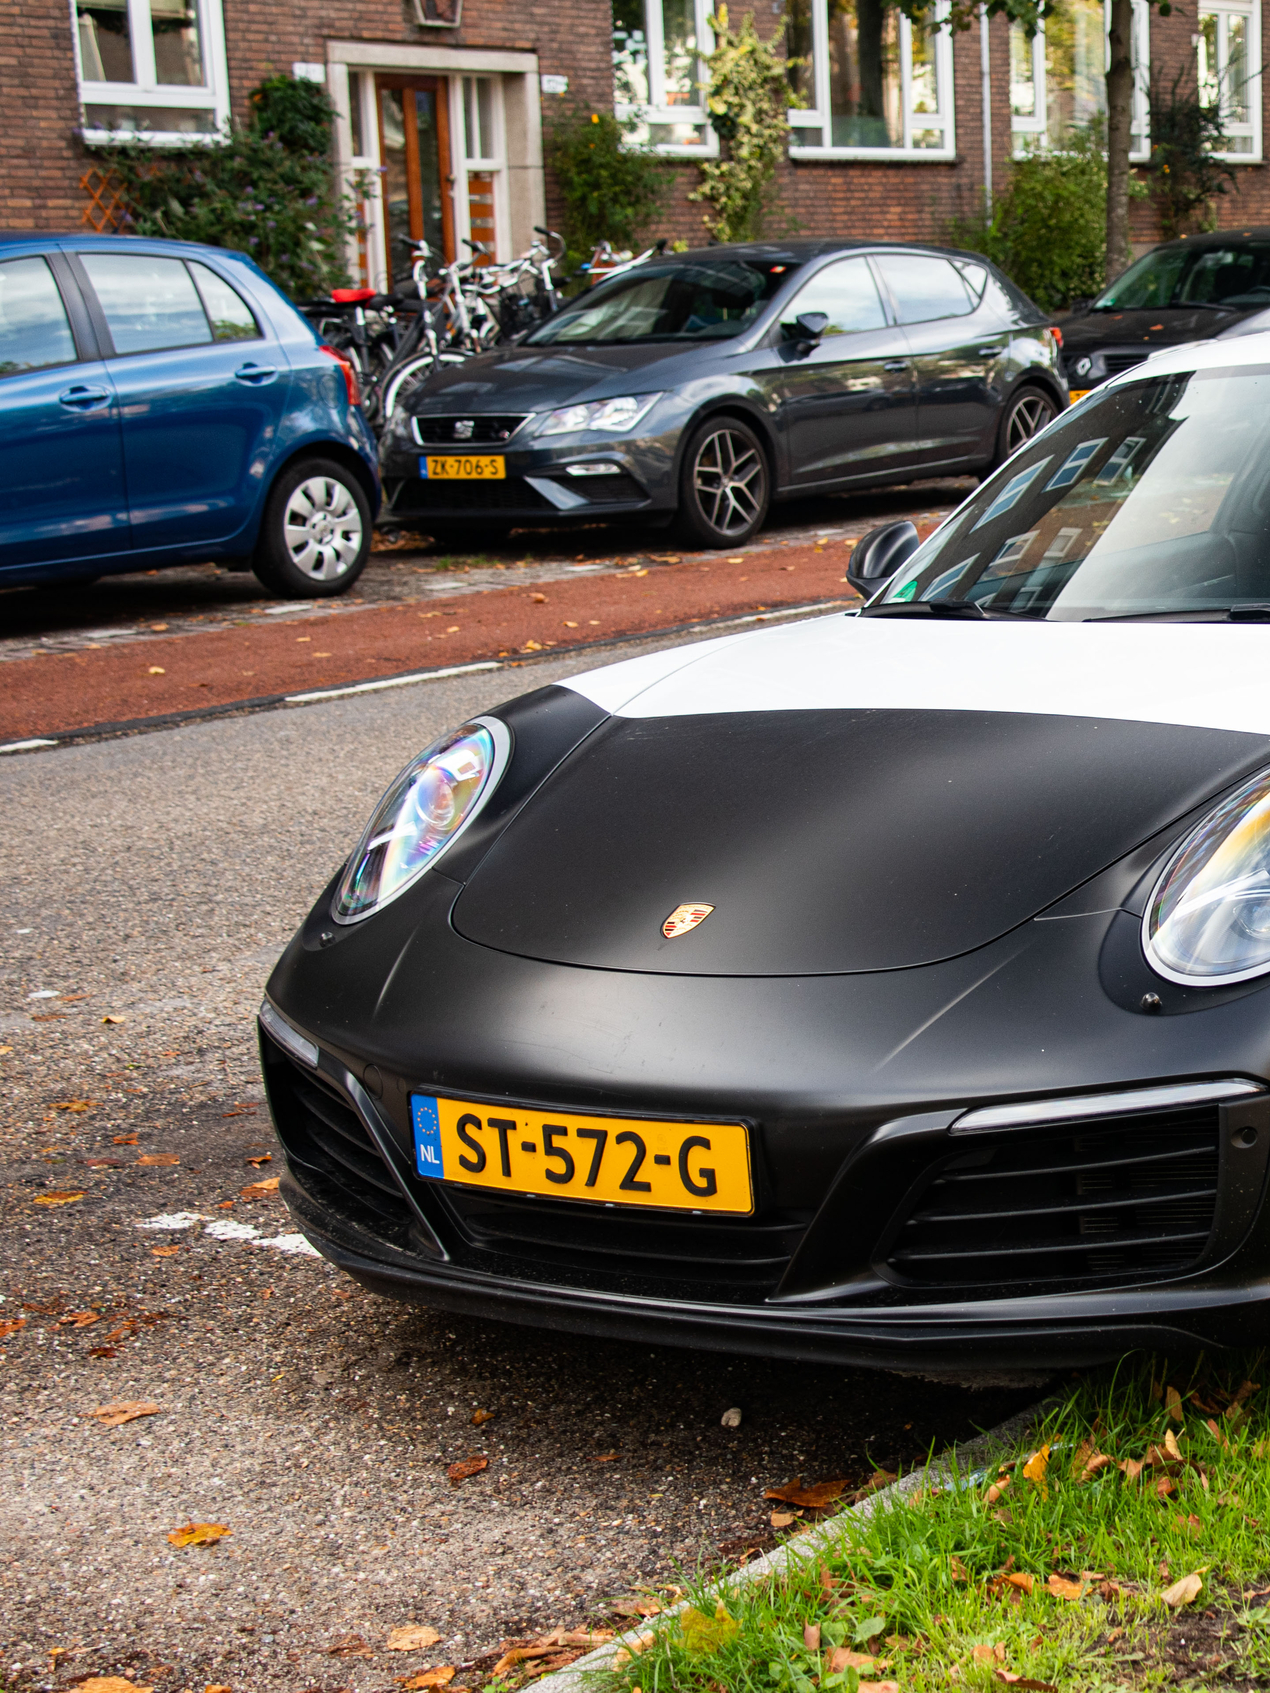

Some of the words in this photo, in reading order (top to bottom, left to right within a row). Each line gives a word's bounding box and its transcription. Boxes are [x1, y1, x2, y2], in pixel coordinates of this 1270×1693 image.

[431, 459, 498, 476] ZK-706-S
[420, 1144, 440, 1165] NL
[456, 1113, 717, 1197] ST-572-G
